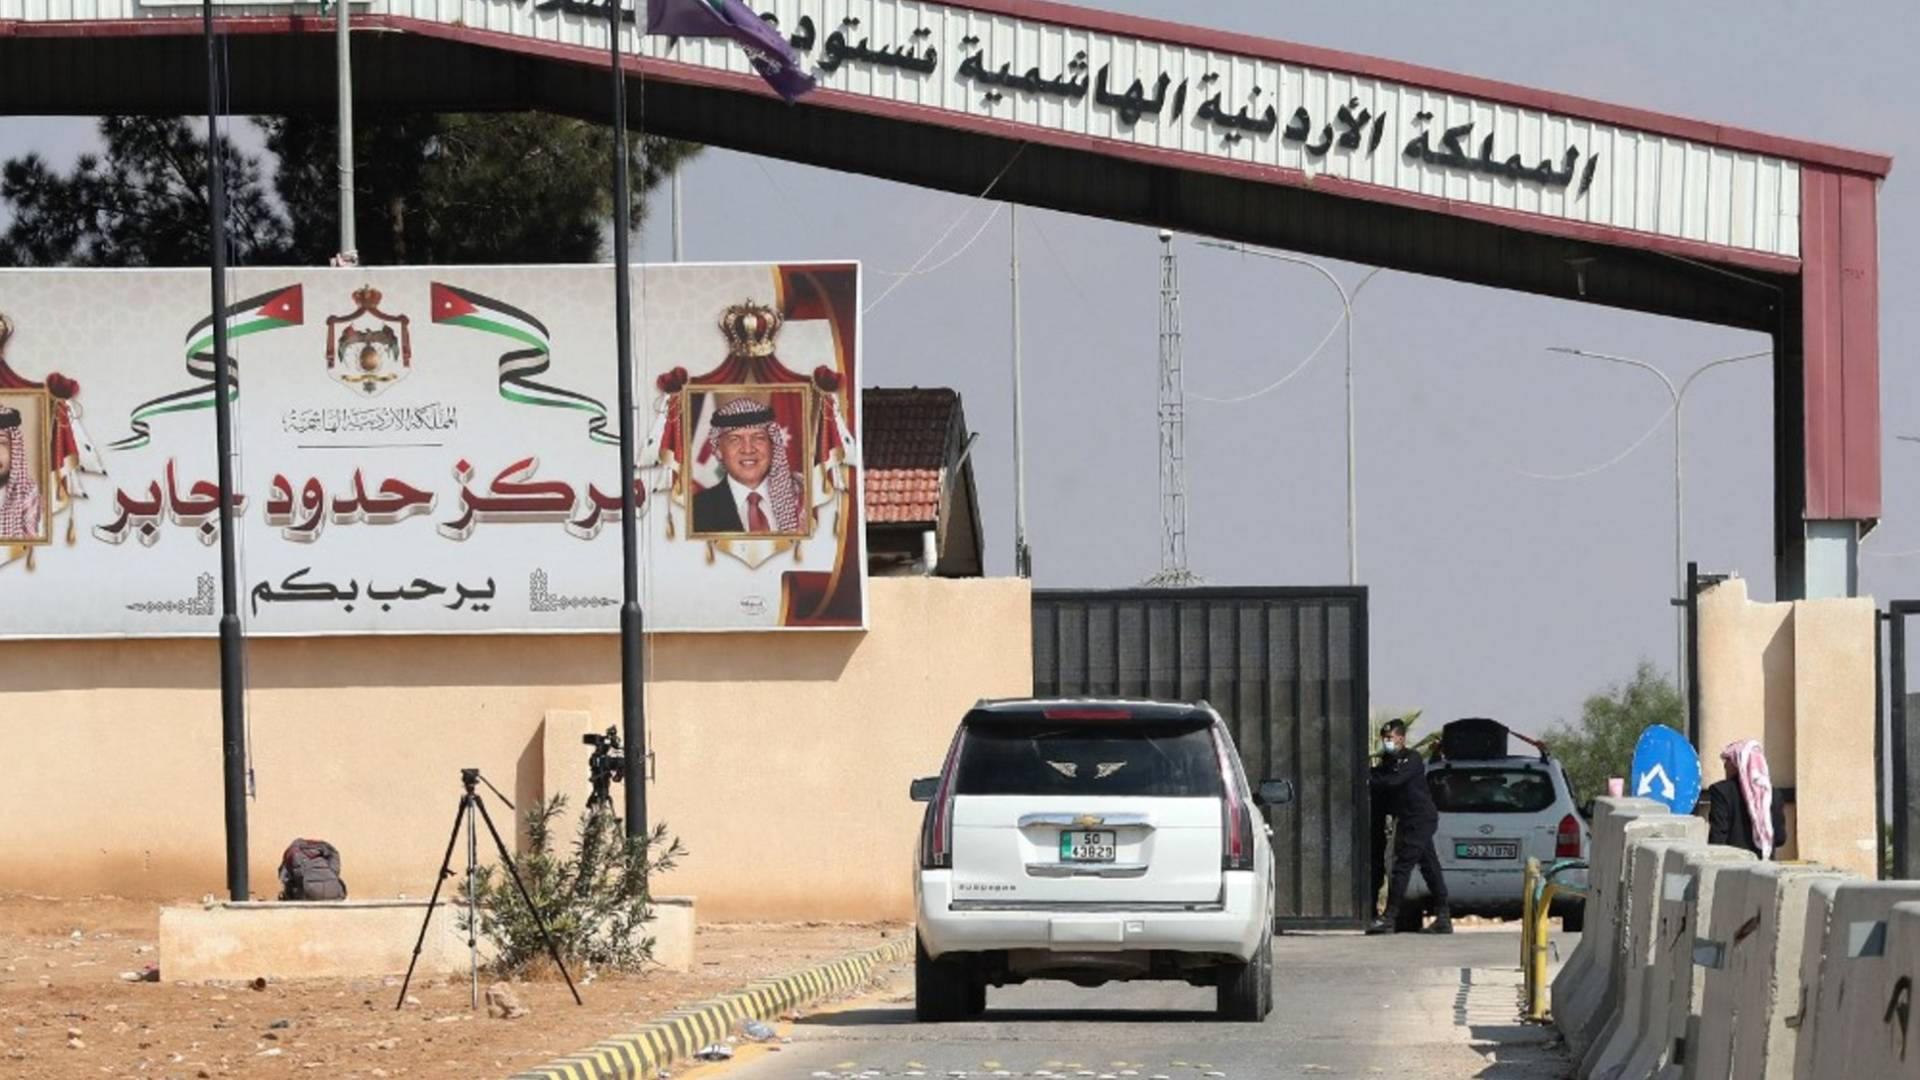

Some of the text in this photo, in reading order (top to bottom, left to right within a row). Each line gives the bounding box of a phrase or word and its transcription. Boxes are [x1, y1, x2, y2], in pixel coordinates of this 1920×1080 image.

[958, 35, 1188, 125] الهاشمية
[1196, 71, 1387, 158] الأردنية
[1404, 110, 1600, 198] المملكة
[92, 455, 650, 547] مركز حدود جابر
[251, 566, 496, 618] يرحب بكم
